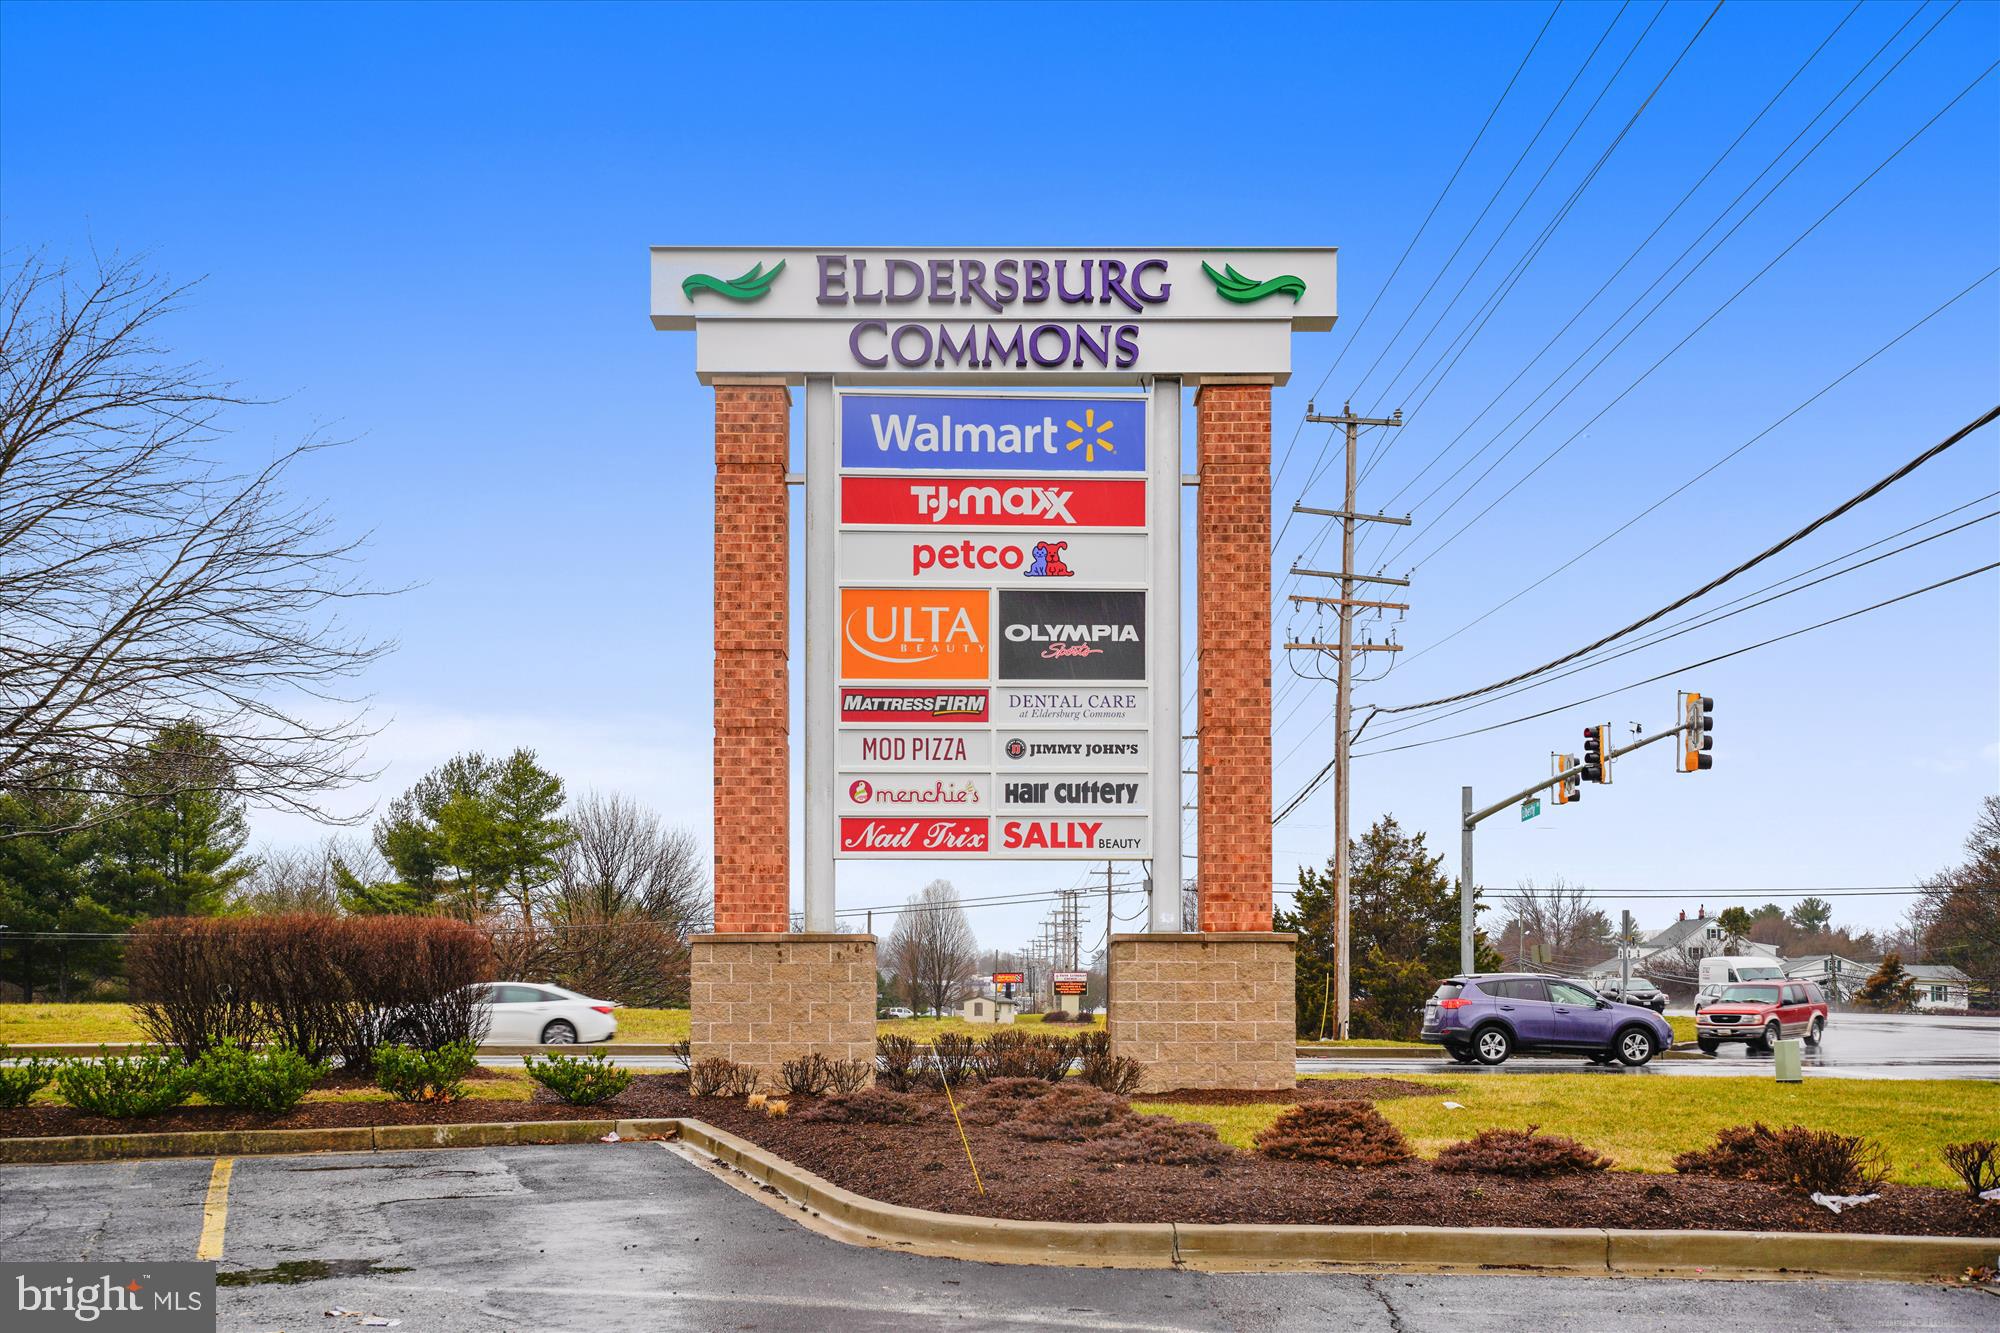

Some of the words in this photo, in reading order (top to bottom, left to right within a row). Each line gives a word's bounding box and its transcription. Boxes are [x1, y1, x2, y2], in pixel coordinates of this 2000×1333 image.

[816, 254, 1171, 313] ELDERSBURG
[849, 320, 1140, 368] COMMONS
[870, 414, 1058, 454] Walmart
[913, 540, 1024, 576] petco
[866, 606, 979, 643] ULTA
[1004, 624, 1140, 642] OLYMPIA
[900, 644, 986, 654] BEAUTY
[1041, 642, 1103, 660] Sports
[1009, 694, 1083, 708] DENTAL
[1088, 694, 1137, 709] CARE
[1019, 709, 1028, 718] at
[1031, 708, 1080, 720] Eldersburg
[1083, 709, 1126, 718] Commons
[863, 737, 905, 760] MOD
[912, 737, 966, 760] PIZZA
[1029, 744, 1082, 757] JIMMY
[1085, 744, 1139, 757] JOHN’S
[876, 781, 979, 803] menchie's
[1005, 782, 1049, 804] Hair
[1054, 780, 1139, 804] cuttery
[845, 821, 920, 848] Nail
[923, 821, 986, 848] Trix
[1003, 821, 1103, 849] SALLY
[1098, 838, 1141, 849] BEAUTY
